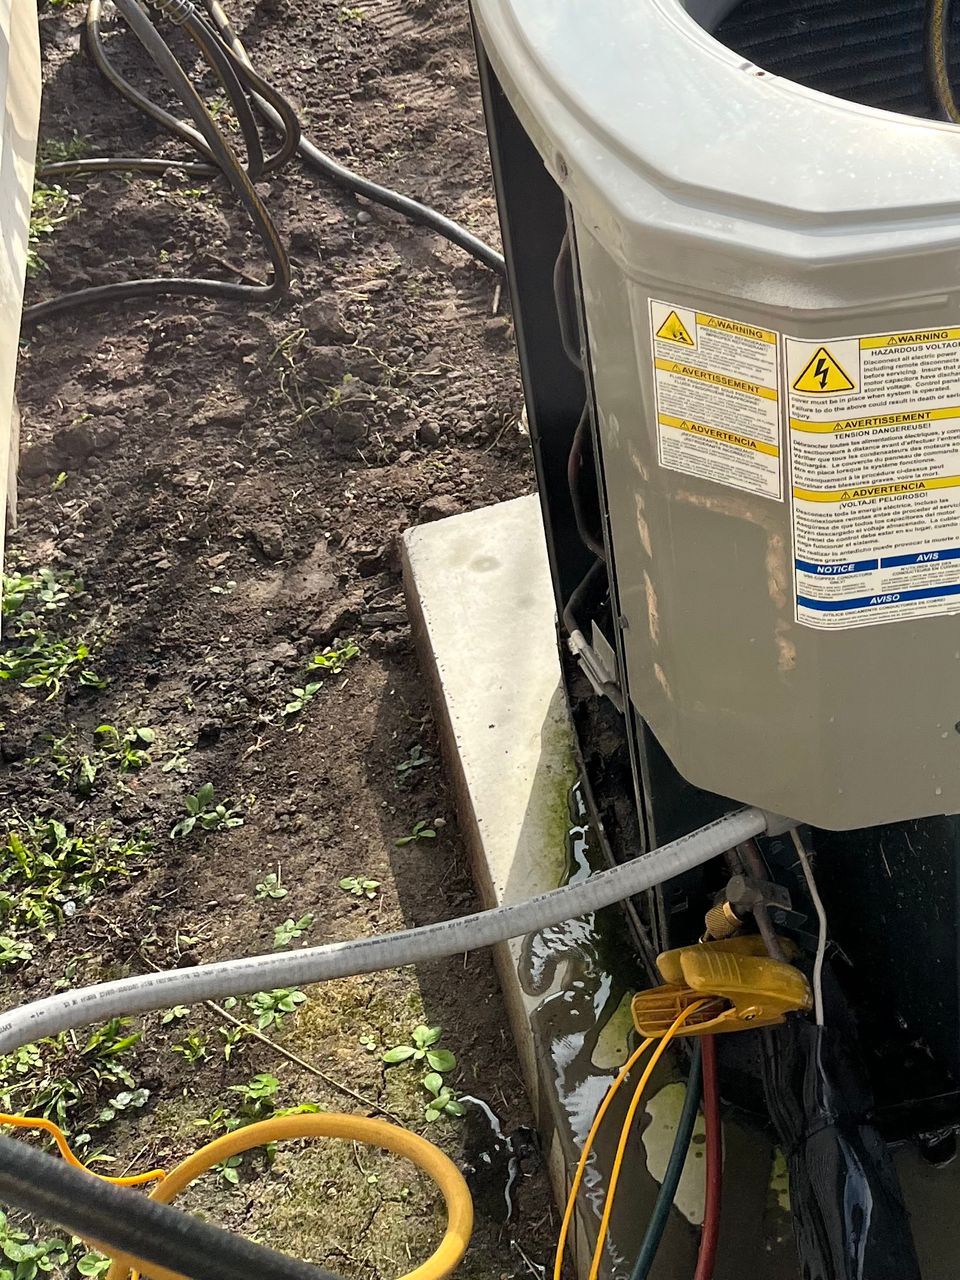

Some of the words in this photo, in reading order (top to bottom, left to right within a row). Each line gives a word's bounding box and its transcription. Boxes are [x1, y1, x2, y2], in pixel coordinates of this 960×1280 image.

[717, 321, 762, 339] WARNING
[898, 332, 948, 343] WARNING
[871, 345, 923, 356] HAZARDOUS
[864, 357, 900, 365] Disconnect
[937, 351, 957, 359] power
[920, 358, 959, 368] disconnects
[682, 367, 760, 393] AVERTISSEMENT
[885, 375, 918, 384] capacitors
[942, 378, 960, 386] panel
[848, 395, 865, 403] place
[887, 390, 910, 399] system
[792, 404, 813, 412] Failure
[869, 400, 887, 408] could
[845, 412, 931, 429] AVERTISSEMENT
[691, 424, 756, 448] ADVERTENCIA
[834, 430, 870, 440] TENSION
[872, 423, 931, 435] DANGEREUSE!
[853, 483, 926, 497] ADVERTENCIA
[839, 498, 876, 510] ¡VOLTAJE
[879, 492, 928, 503] PELIGROSO!
[916, 552, 939, 562] AVIS
[817, 564, 855, 573] NOTICE
[870, 594, 900, 605] AVISO
